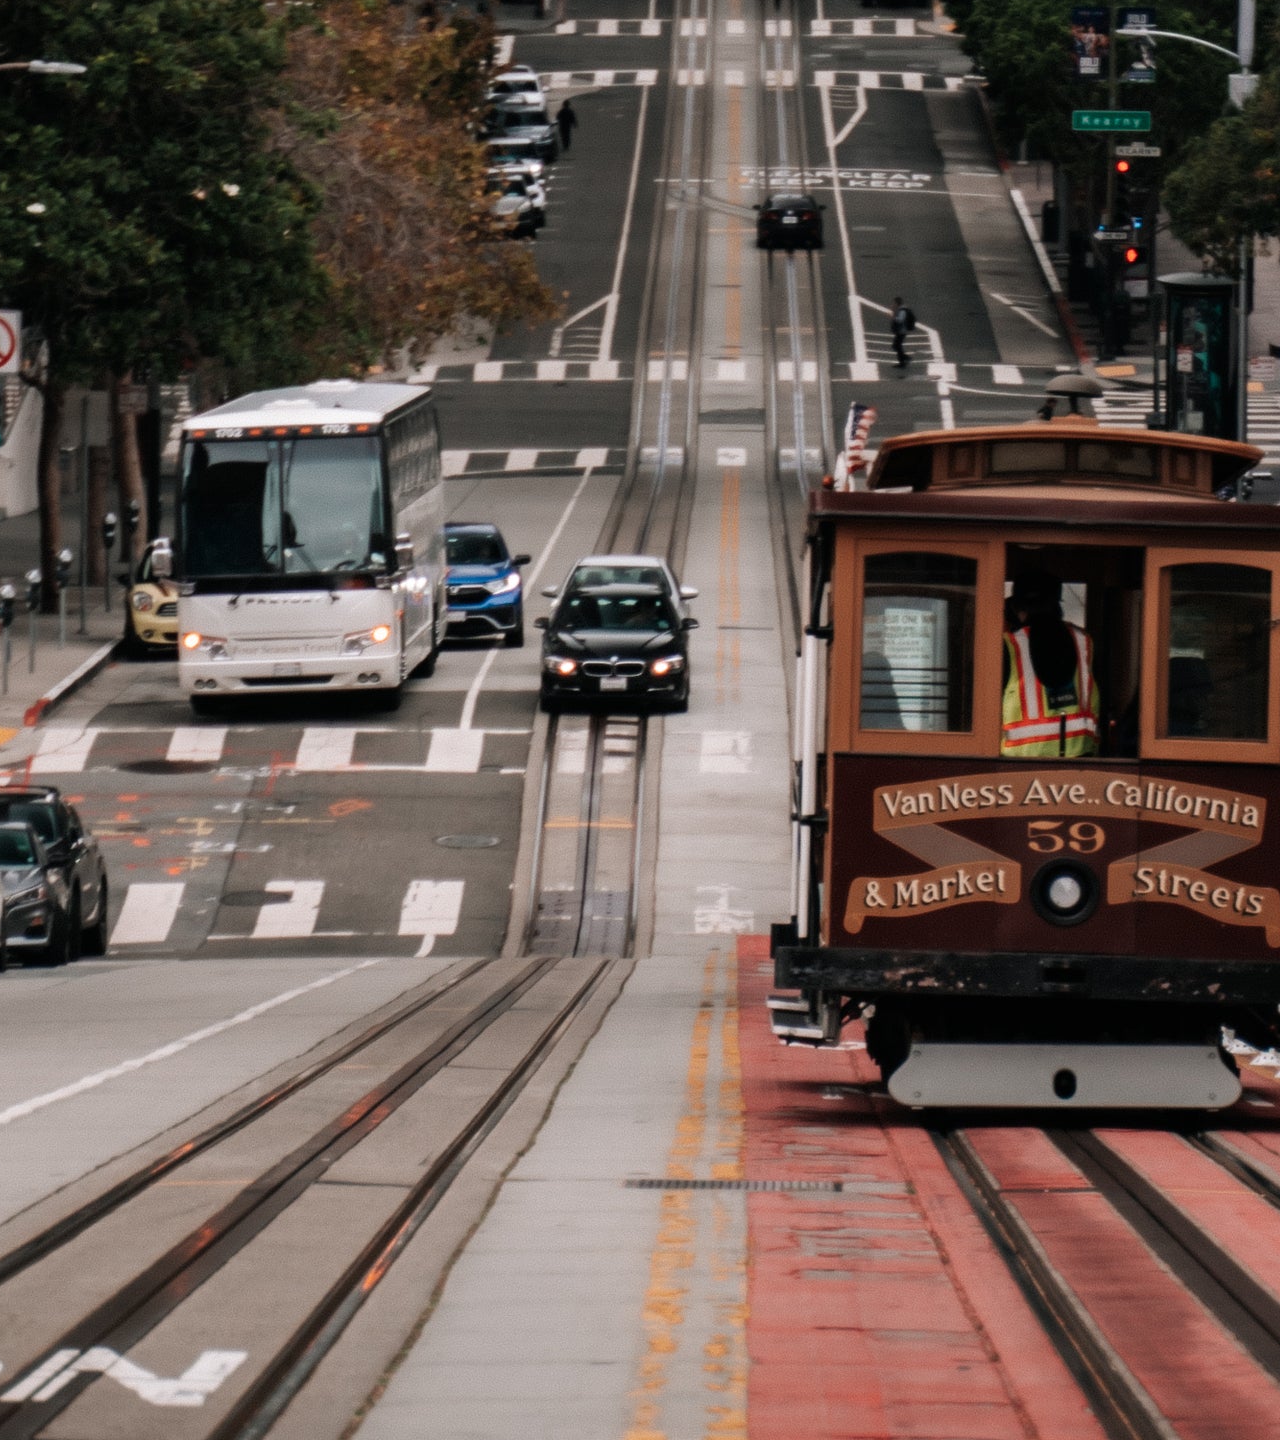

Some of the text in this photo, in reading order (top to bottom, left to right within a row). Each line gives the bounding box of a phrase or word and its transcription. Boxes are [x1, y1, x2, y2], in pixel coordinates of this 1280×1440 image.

[1082, 115, 1142, 128] Kearny
[215, 428, 243, 438] 1702
[321, 424, 351, 434] 1702
[880, 789, 935, 819] Van
[939, 780, 1014, 811] Ness
[1106, 778, 1260, 829] California
[1026, 820, 1107, 854] 59
[864, 866, 1265, 916] & Market Streets
